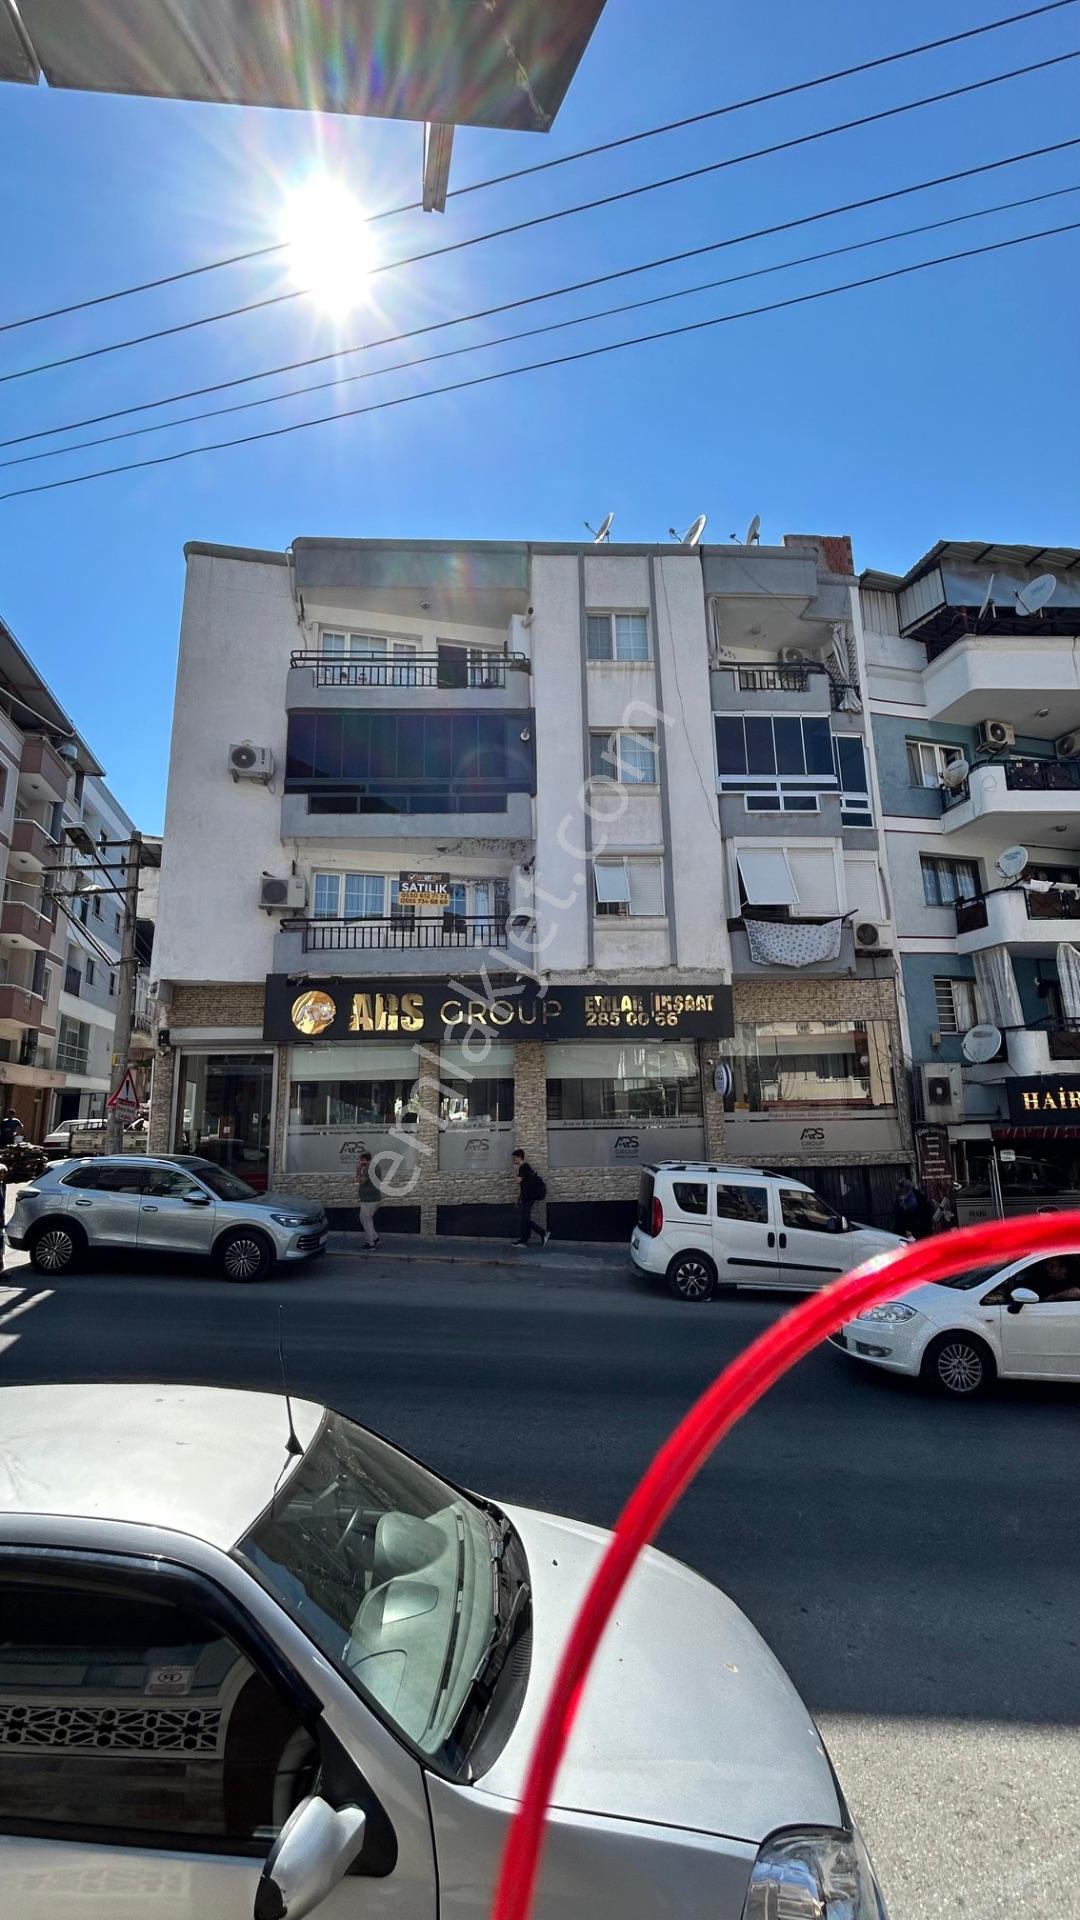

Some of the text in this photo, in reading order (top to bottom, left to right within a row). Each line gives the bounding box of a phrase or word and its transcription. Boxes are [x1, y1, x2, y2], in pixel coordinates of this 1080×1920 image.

[401, 882, 447, 893] SATILIK
[348, 992, 562, 1032] ARS GROUP
[585, 1012, 620, 1026] 285
[800, 1127, 825, 1140] ARS
[339, 1141, 366, 1154] ARS
[463, 1138, 490, 1151] ARS
[614, 1135, 640, 1149] ARS
